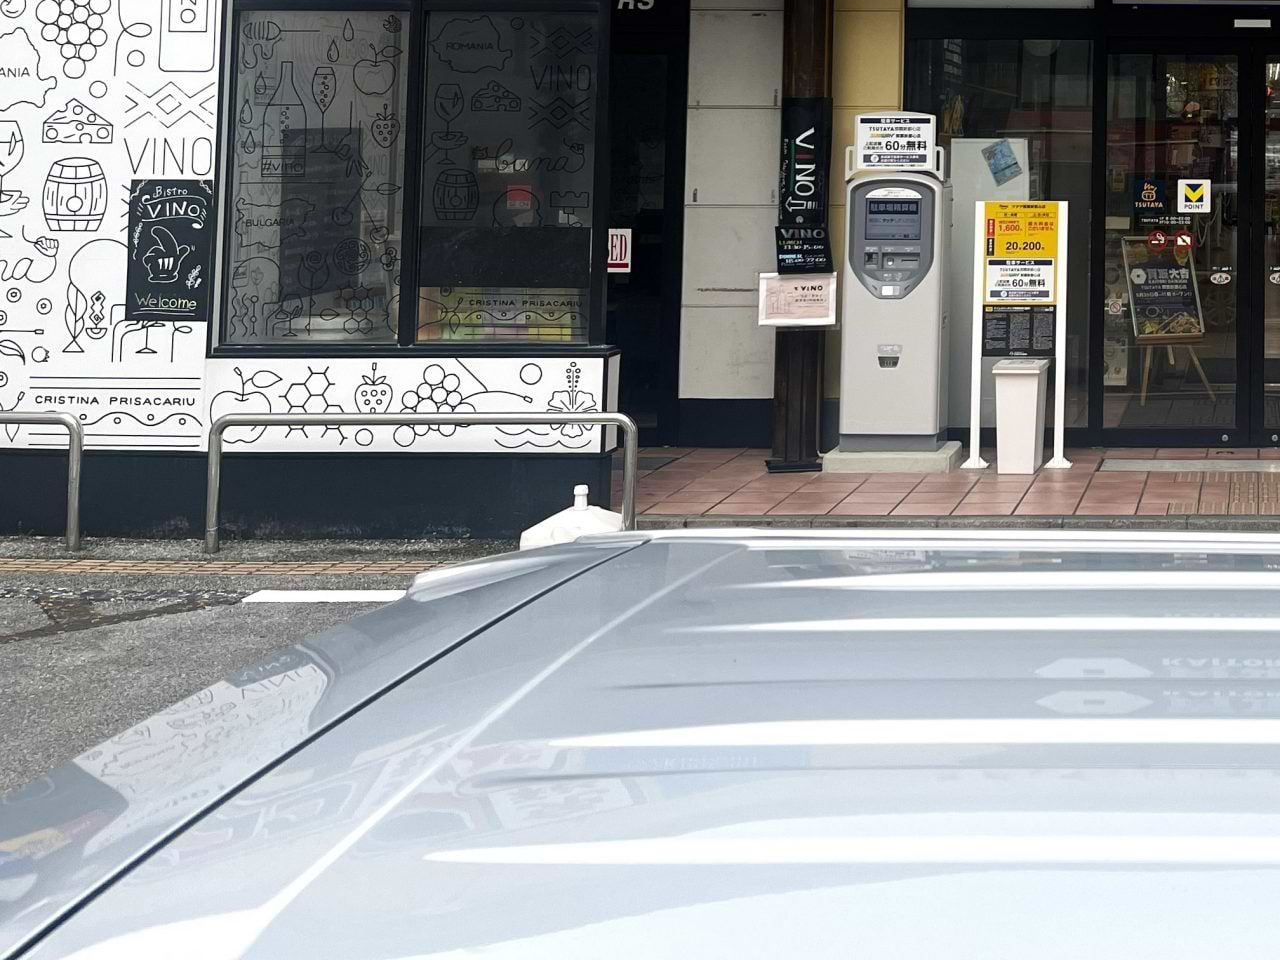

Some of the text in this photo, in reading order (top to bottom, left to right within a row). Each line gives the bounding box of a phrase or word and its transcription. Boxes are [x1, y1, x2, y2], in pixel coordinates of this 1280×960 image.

[445, 42, 495, 51] ROMANIA
[529, 64, 592, 91] VINO
[123, 136, 213, 176] VINO
[794, 126, 816, 197] VINO
[261, 159, 304, 173] #vino
[152, 185, 189, 199] Bistro
[146, 200, 201, 219] VINO
[245, 218, 295, 228] BULGARIA
[780, 228, 826, 239] VINO
[134, 291, 198, 311] Welcome
[468, 298, 516, 307] CRISTINA
[34, 395, 196, 407] CRISTINA PRISACARIU
